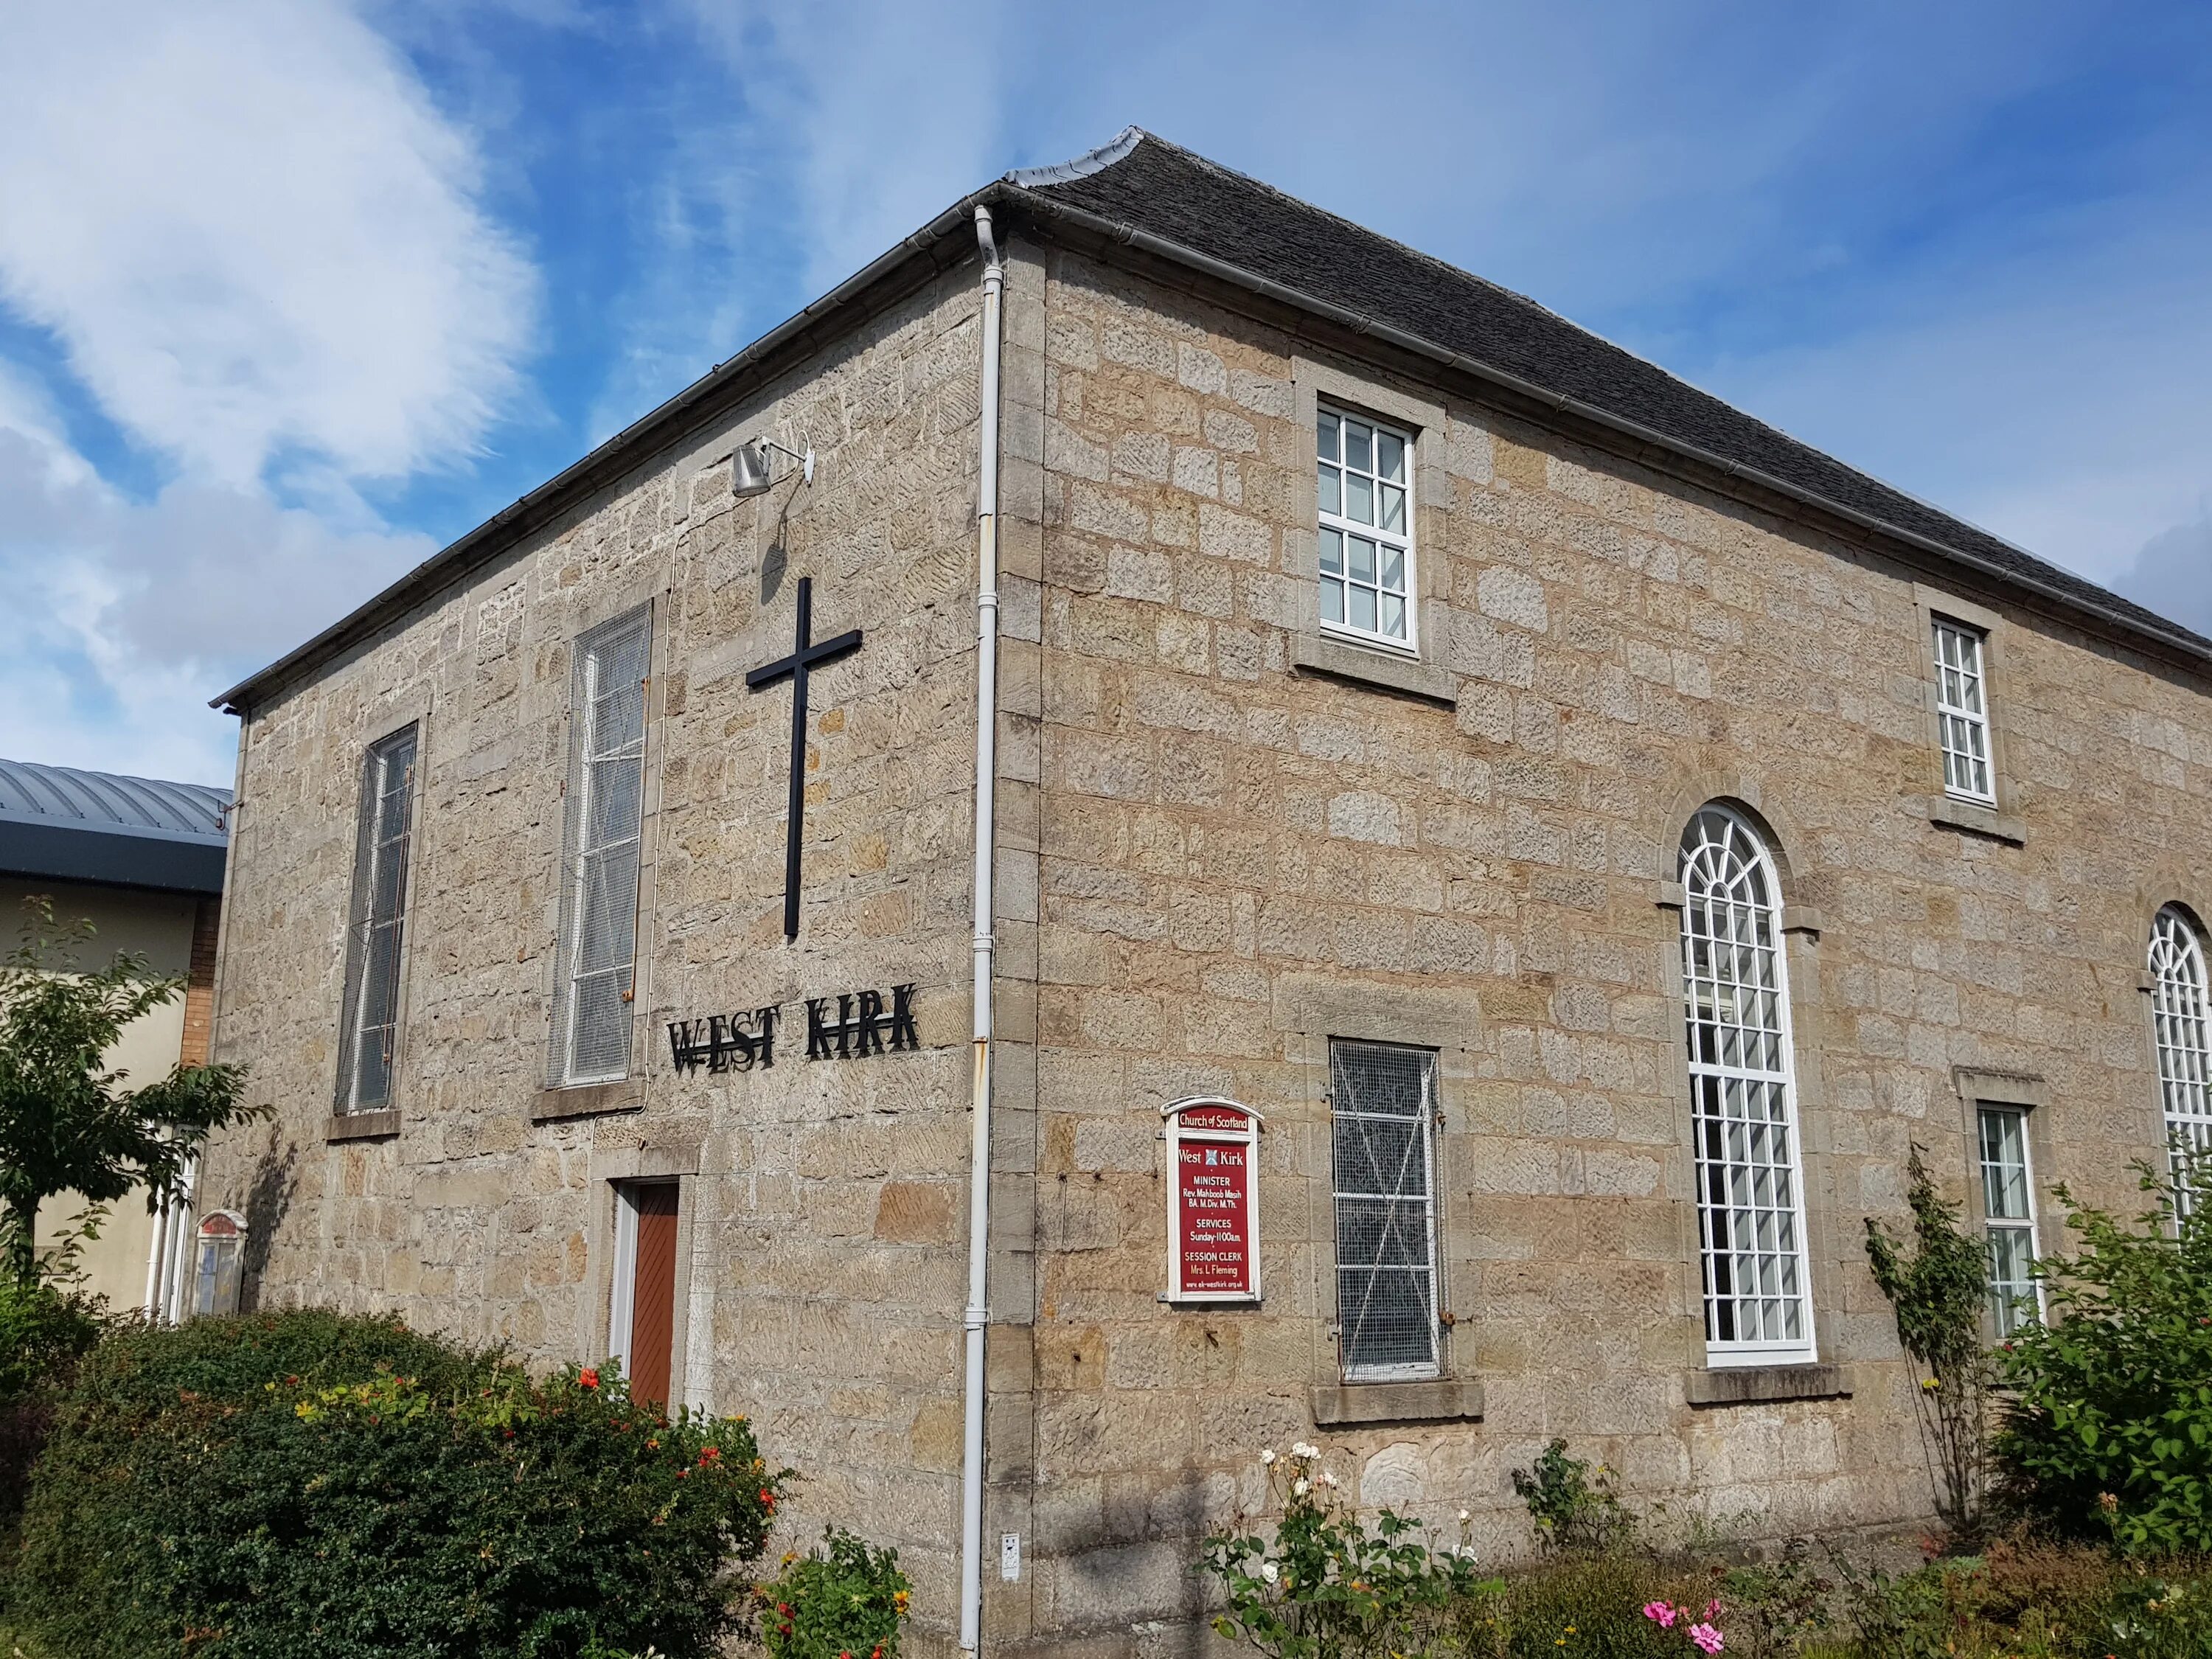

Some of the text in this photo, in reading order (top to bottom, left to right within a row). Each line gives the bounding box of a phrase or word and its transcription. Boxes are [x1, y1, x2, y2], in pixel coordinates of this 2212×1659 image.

[667, 982, 917, 1071] WEST KIRK
[1180, 1113, 1248, 1129] Church of Scotland
[1179, 1149, 1243, 1166] West Kirk
[1193, 1175, 1230, 1186] MINISTER
[1183, 1188, 1242, 1199] Rev. Mahboob Masih
[1196, 1219, 1231, 1228] SERVICES
[1185, 1252, 1242, 1262] SESSION CLERK
[1205, 1265, 1210, 1274] L
[1211, 1265, 1238, 1277] Fleming
